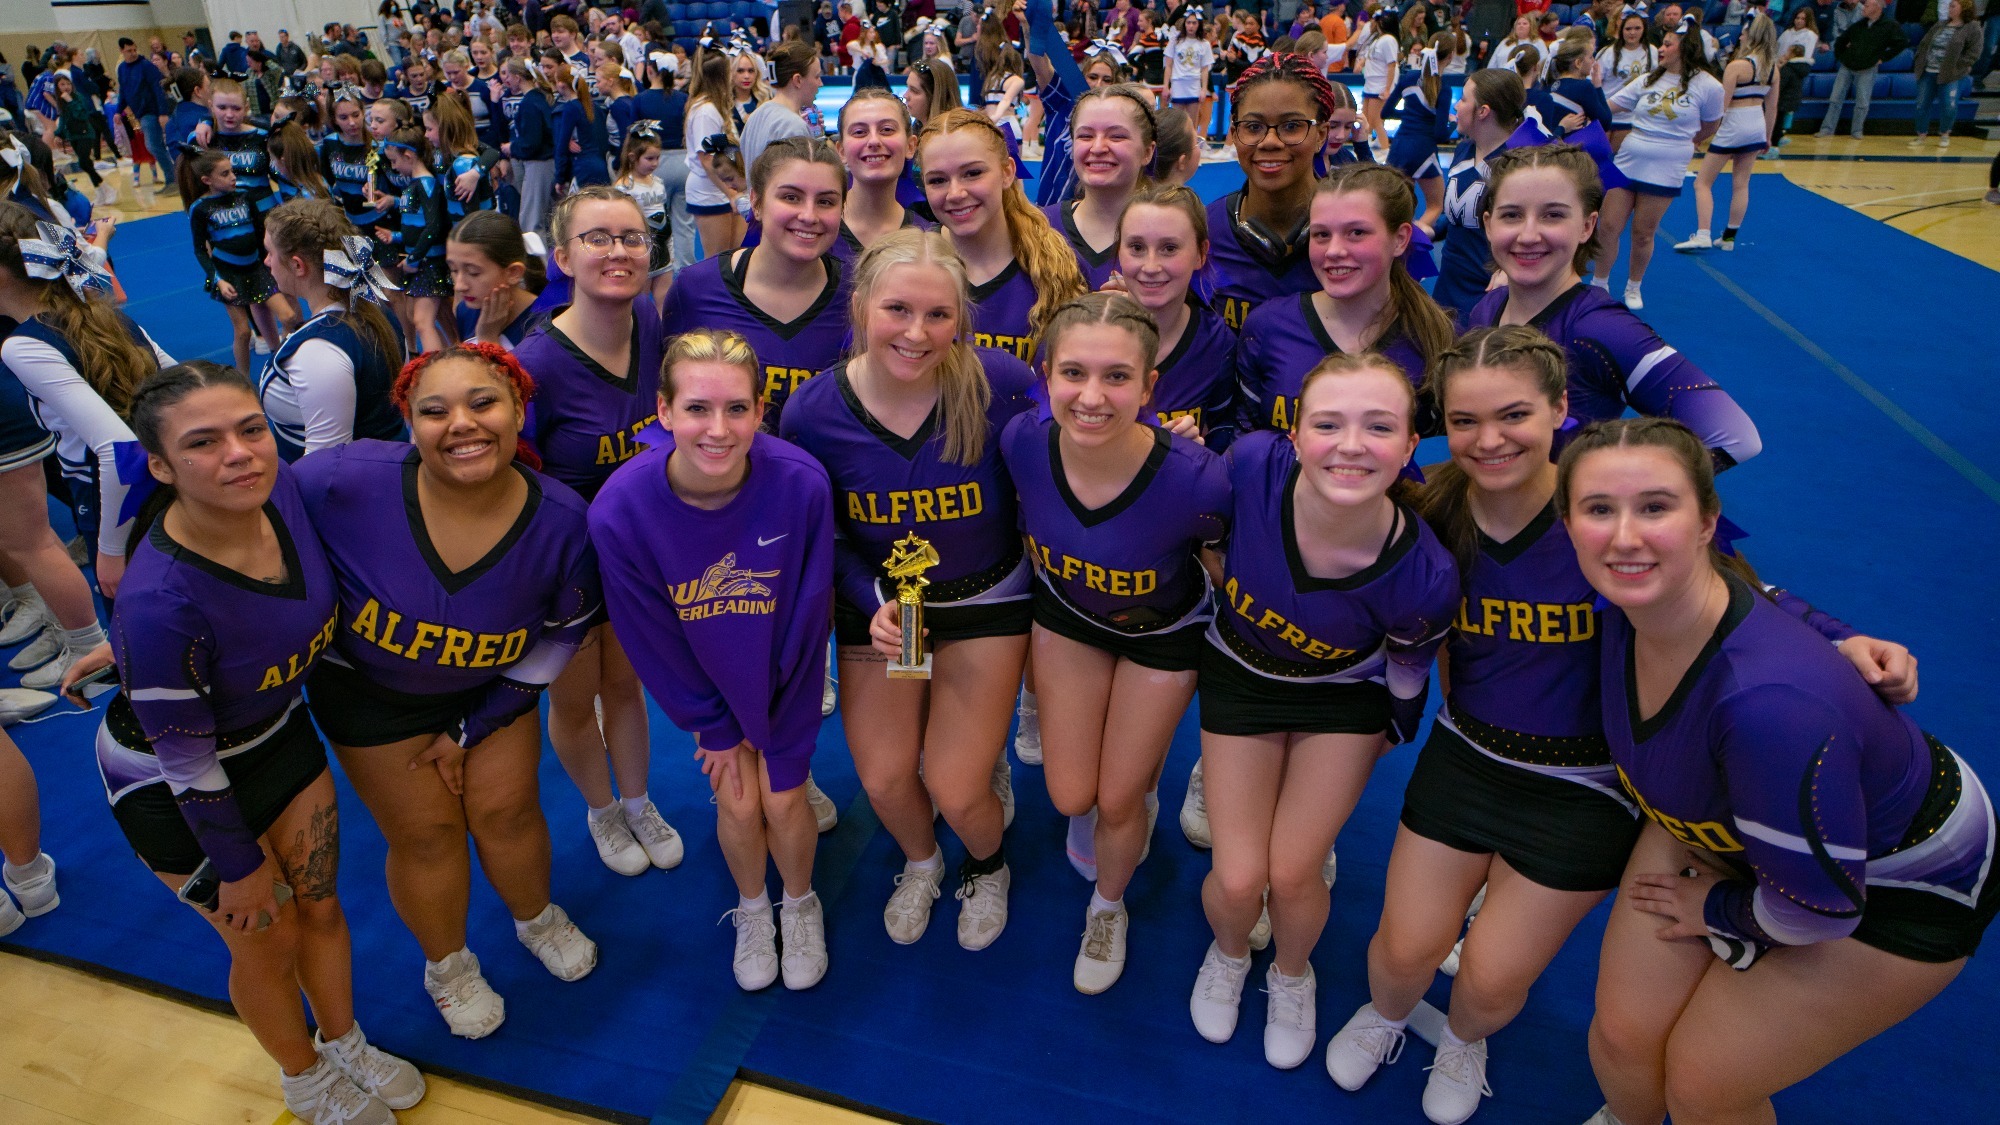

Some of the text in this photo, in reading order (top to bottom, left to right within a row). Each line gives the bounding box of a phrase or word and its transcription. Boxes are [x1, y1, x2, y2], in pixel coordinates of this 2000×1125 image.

[227, 152, 255, 166] CW
[331, 162, 368, 179] WCW
[213, 208, 248, 224] WCW
[1444, 177, 1485, 229] M
[848, 481, 983, 524] ALFRED
[676, 596, 777, 621] ERLEADIN
[1451, 597, 1595, 643] LFRED
[255, 602, 339, 692] ALFR
[351, 597, 528, 668] ALFRED
